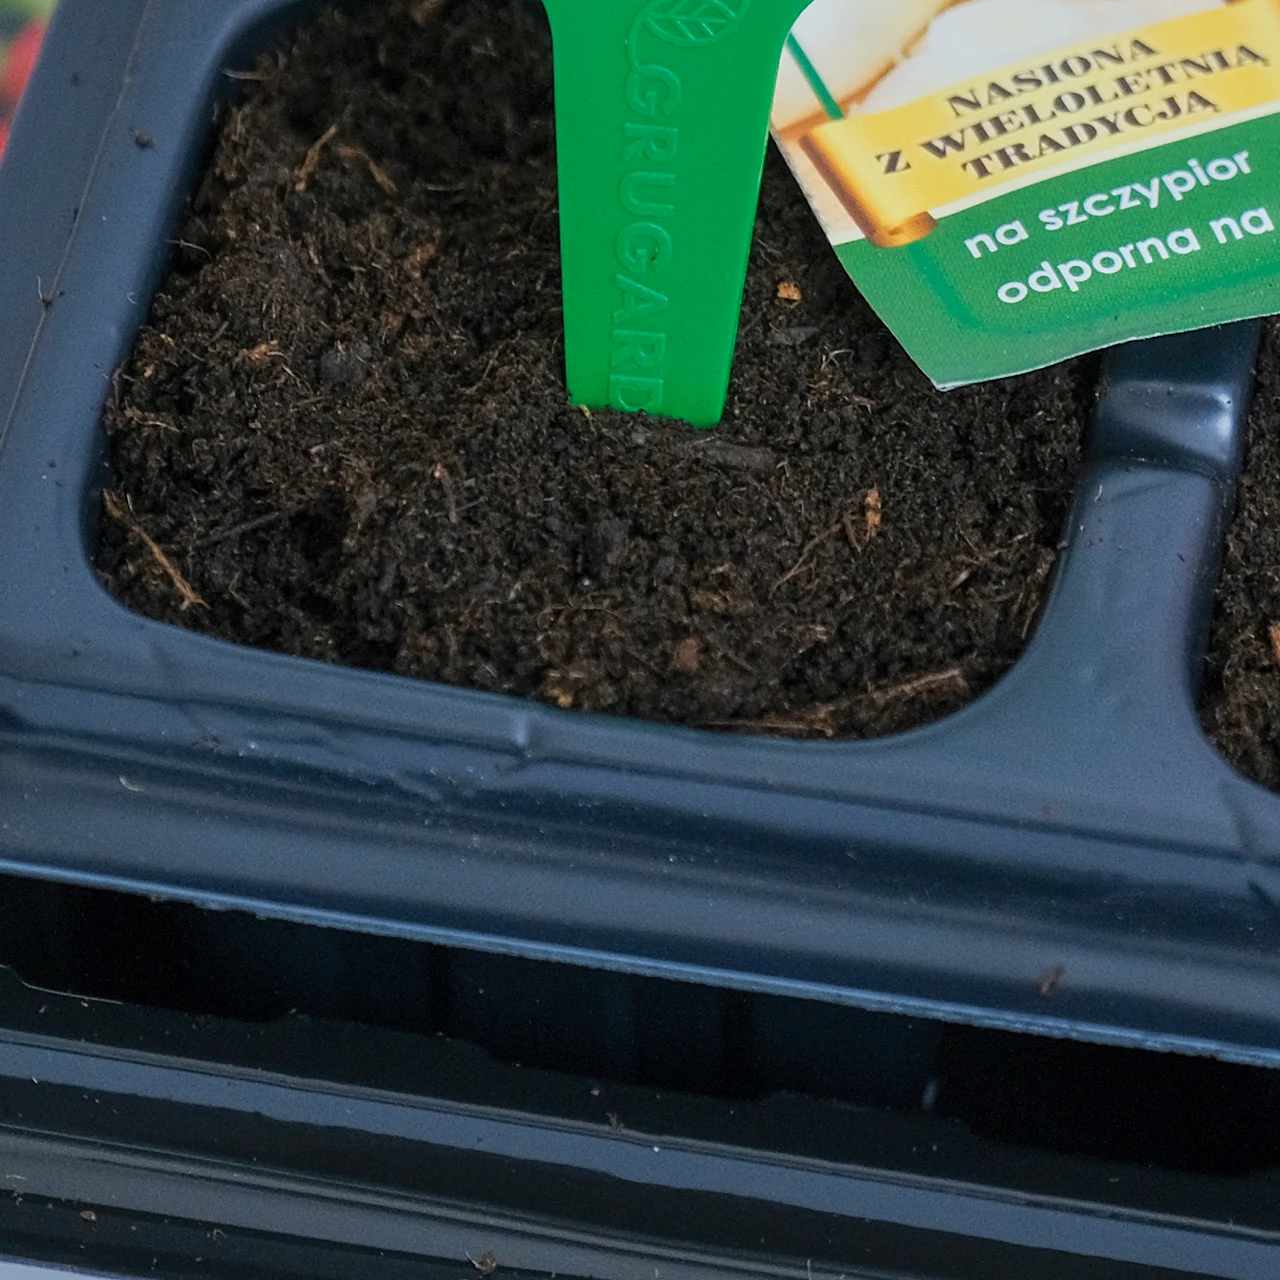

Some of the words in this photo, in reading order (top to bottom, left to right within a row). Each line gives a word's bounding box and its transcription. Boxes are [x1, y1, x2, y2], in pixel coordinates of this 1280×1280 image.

[876, 149, 912, 176] Z
[920, 42, 1271, 161] WIELOLETNIĄ
[946, 36, 1158, 118] NASIONA
[962, 89, 1221, 180] TRADYCJĄ
[963, 219, 1029, 259] na
[1038, 151, 1253, 232] szczypior
[997, 228, 1201, 304] odporna
[1208, 206, 1275, 245] na
